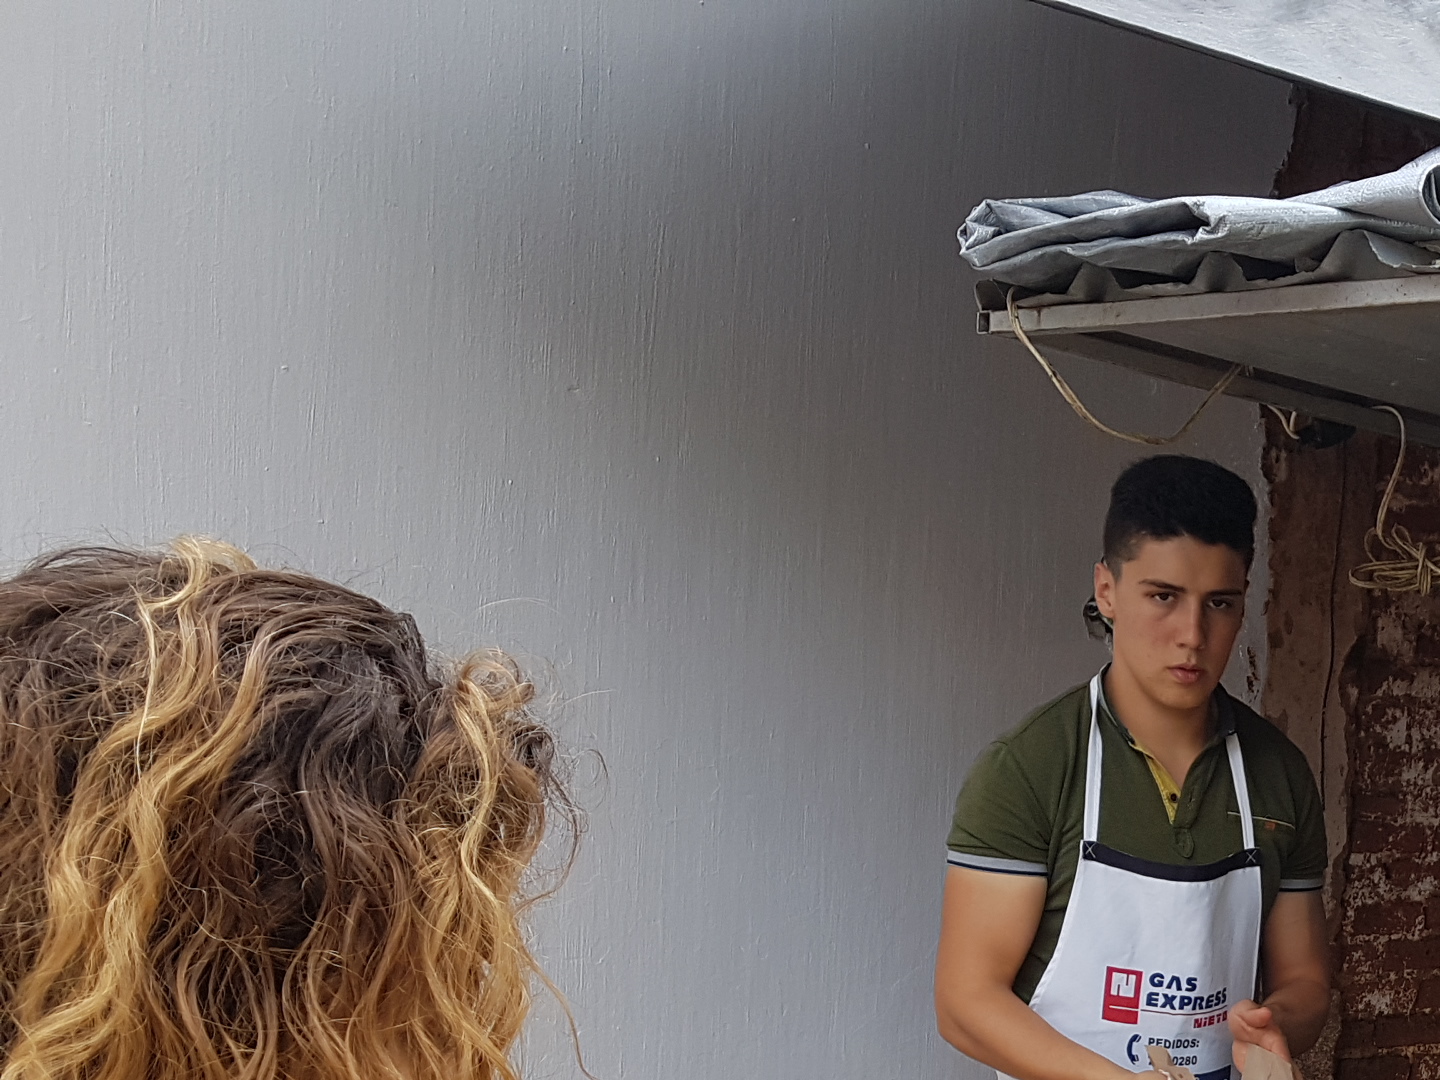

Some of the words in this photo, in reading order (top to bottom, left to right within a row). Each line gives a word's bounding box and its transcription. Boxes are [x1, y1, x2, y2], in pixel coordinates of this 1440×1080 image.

[1149, 972, 1197, 992] GAS
[1146, 987, 1227, 1010] EXPRESS
[1148, 1037, 1200, 1049] PEDIDOS:
